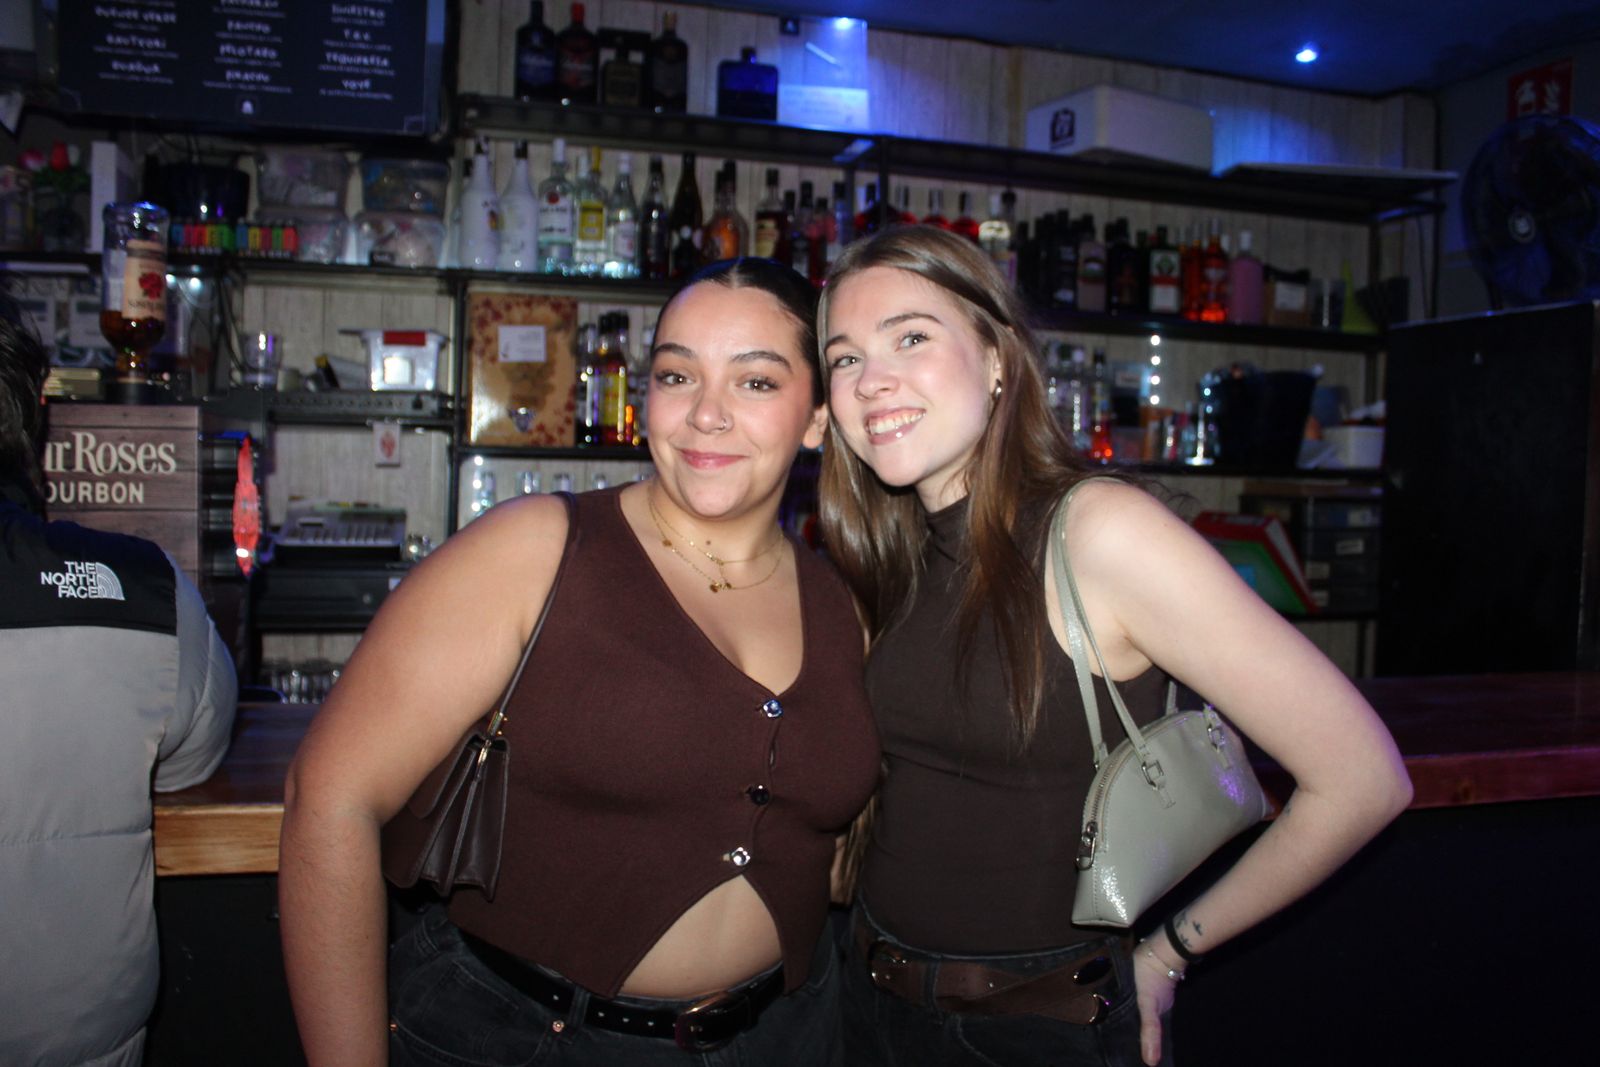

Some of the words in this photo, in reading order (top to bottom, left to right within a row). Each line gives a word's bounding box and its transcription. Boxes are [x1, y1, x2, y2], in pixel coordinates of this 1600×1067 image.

[72, 431, 177, 476] Roses
[64, 561, 96, 574] THE
[40, 571, 97, 586] NORTH
[58, 585, 99, 599] FACE
